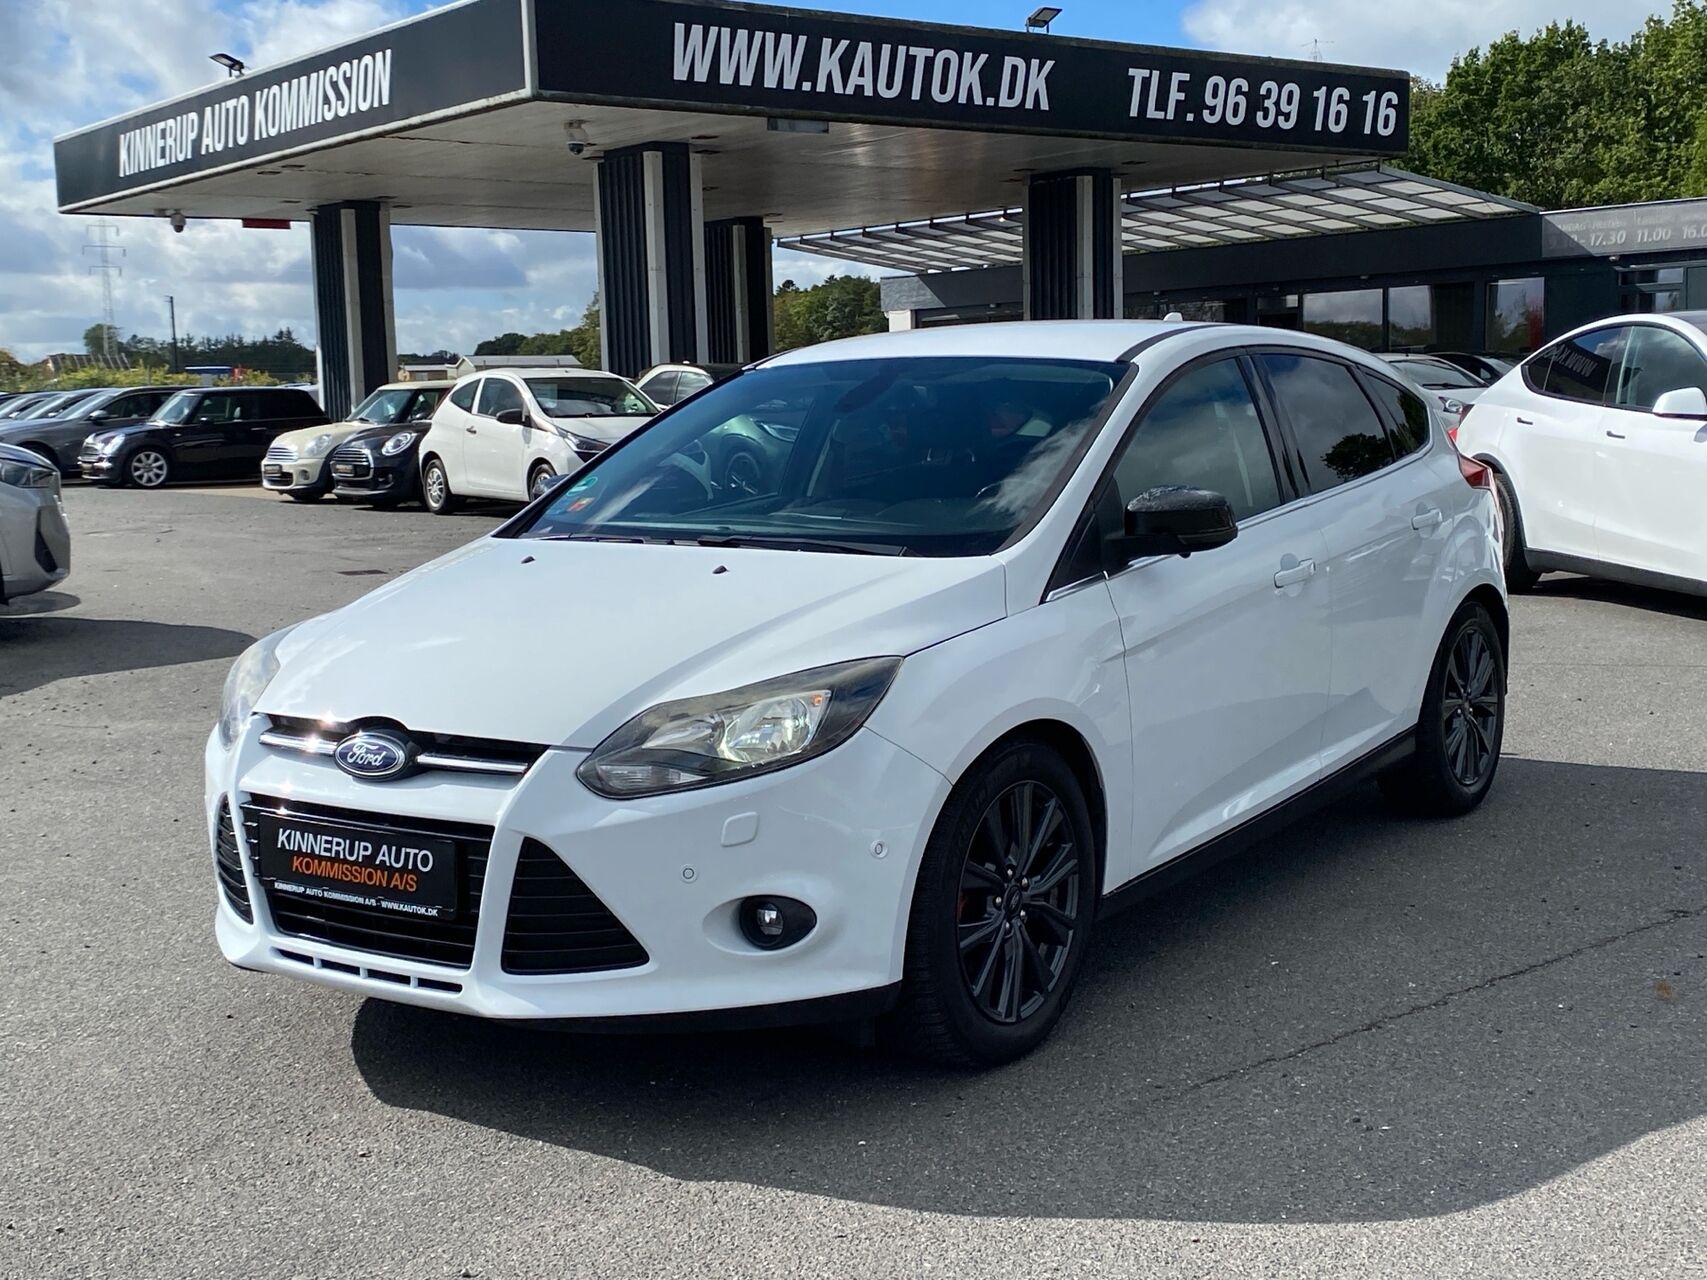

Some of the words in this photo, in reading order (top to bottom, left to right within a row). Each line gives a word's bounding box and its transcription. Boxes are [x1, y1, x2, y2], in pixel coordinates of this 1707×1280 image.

[673, 22, 1055, 111] WWW.KAUTOK.DK
[119, 112, 198, 177] KINNERUP
[201, 95, 249, 154] AUTO
[254, 49, 392, 140] KOMMISSION
[1128, 68, 1194, 121] TLF.
[1202, 75, 1249, 126] 96
[1256, 80, 1300, 130] 39
[1313, 86, 1350, 133] 16
[1362, 91, 1399, 137] 16
[1590, 230, 1626, 246] 17.30
[1637, 228, 1671, 243] 11.00
[347, 742, 387, 767] Ford
[277, 828, 372, 863] KINNERUP
[375, 844, 434, 873] AUTO
[292, 855, 387, 888] KOMMISSION
[390, 872, 417, 892] A/S
[274, 881, 304, 894] KINNERUP
[305, 887, 323, 898] AUTO
[324, 888, 364, 905] KOMMISSION
[365, 897, 376, 907] A/S
[381, 900, 439, 917] WWW.KAUTOK.DK
